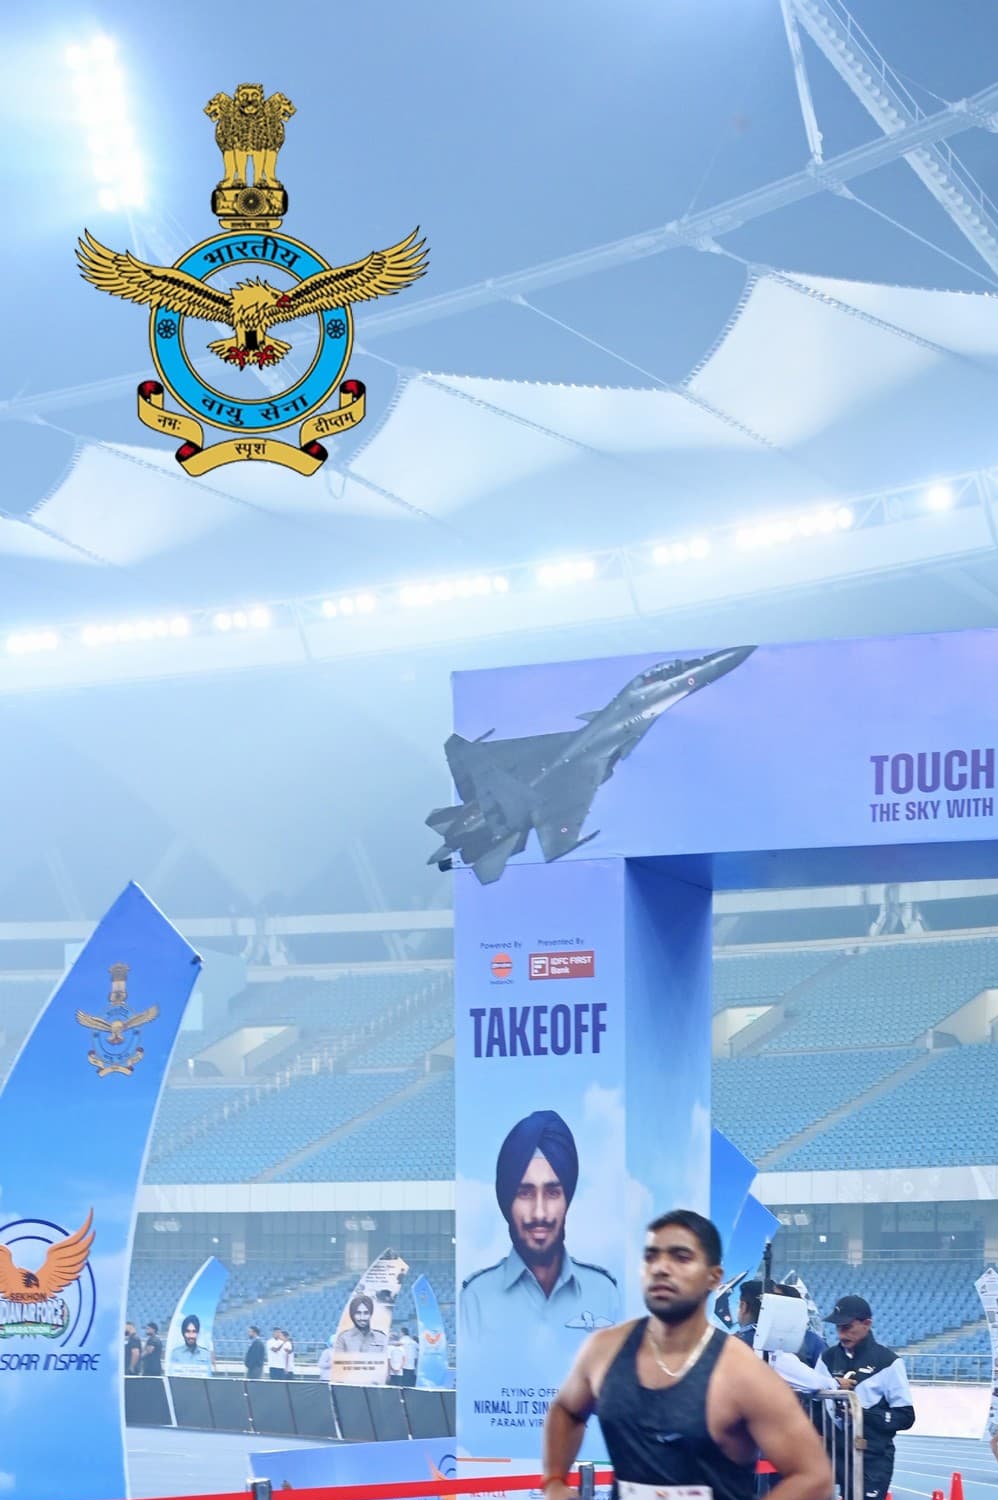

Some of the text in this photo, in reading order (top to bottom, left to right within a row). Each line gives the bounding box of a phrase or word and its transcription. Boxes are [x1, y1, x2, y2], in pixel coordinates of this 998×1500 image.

[870, 748, 995, 796] TOUCH
[870, 797, 994, 823] THE SKY WITH
[550, 955, 593, 966] IDFC FIRST
[469, 1003, 607, 1058] TAKEOFF
[0, 1353, 101, 1370] SOAR INSPIRE
[501, 1388, 535, 1397] FLYING
[474, 1400, 549, 1414] NIRMAL JIT SIN
[490, 1418, 525, 1427] PARAM
